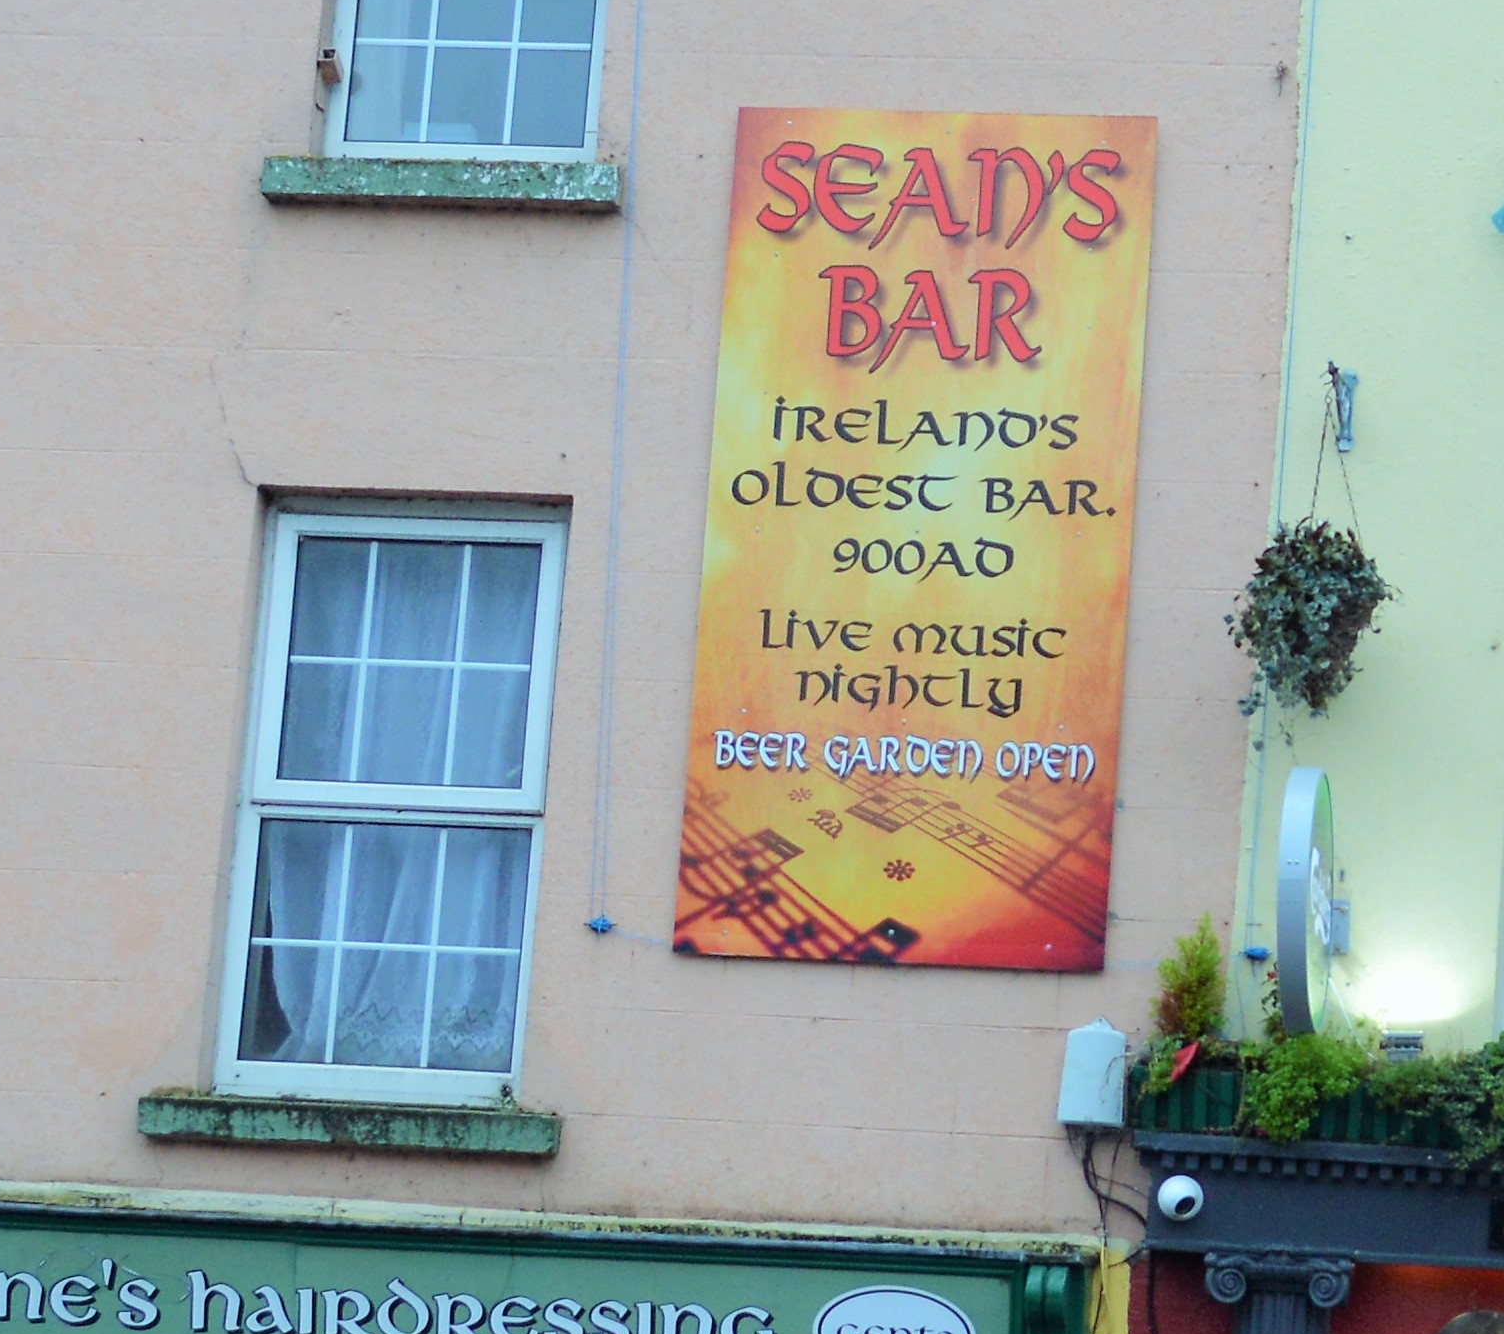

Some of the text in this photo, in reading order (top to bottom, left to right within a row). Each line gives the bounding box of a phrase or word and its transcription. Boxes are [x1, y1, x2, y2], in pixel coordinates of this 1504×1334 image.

[756, 141, 1121, 250] SEAN'S
[819, 265, 1042, 373] BAR
[979, 477, 1117, 521] BAR.
[833, 536, 1015, 583] 900AD
[714, 729, 1096, 783] BEER GARDEN OPEN
